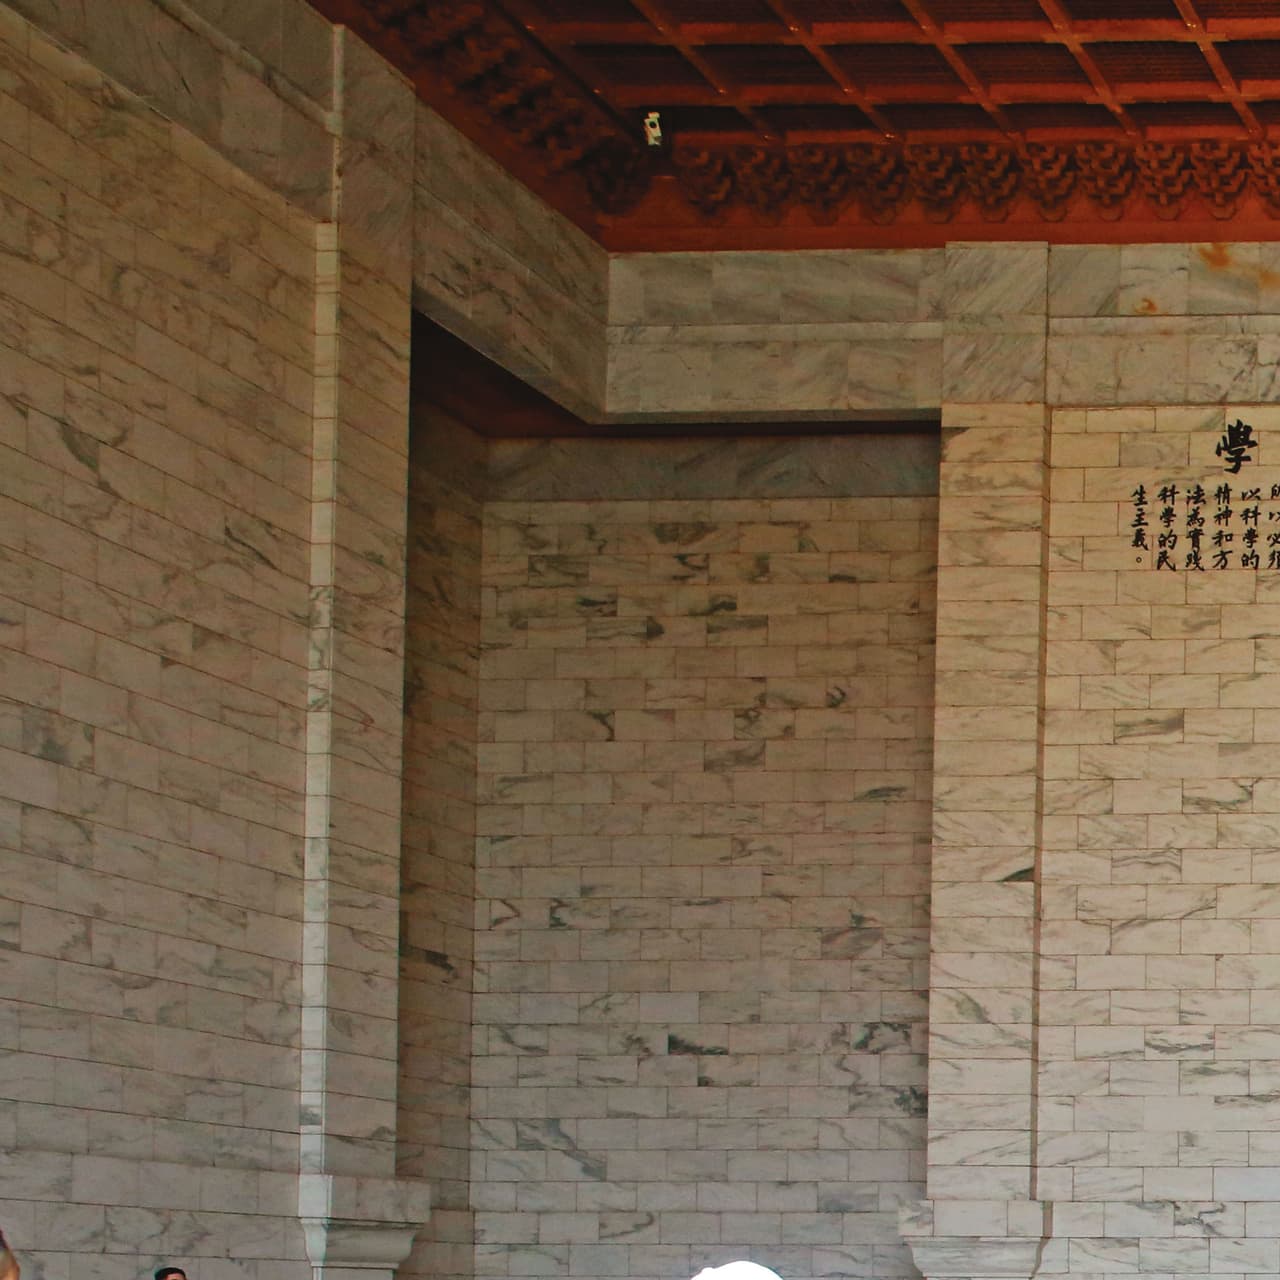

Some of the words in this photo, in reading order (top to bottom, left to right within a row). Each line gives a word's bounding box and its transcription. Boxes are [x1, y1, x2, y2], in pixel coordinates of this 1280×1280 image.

[1131, 485, 1150, 565] 生主義。
[1156, 483, 1180, 573] 科學的民
[1211, 482, 1234, 571] 精神和方
[1239, 487, 1262, 571] 以科學的
